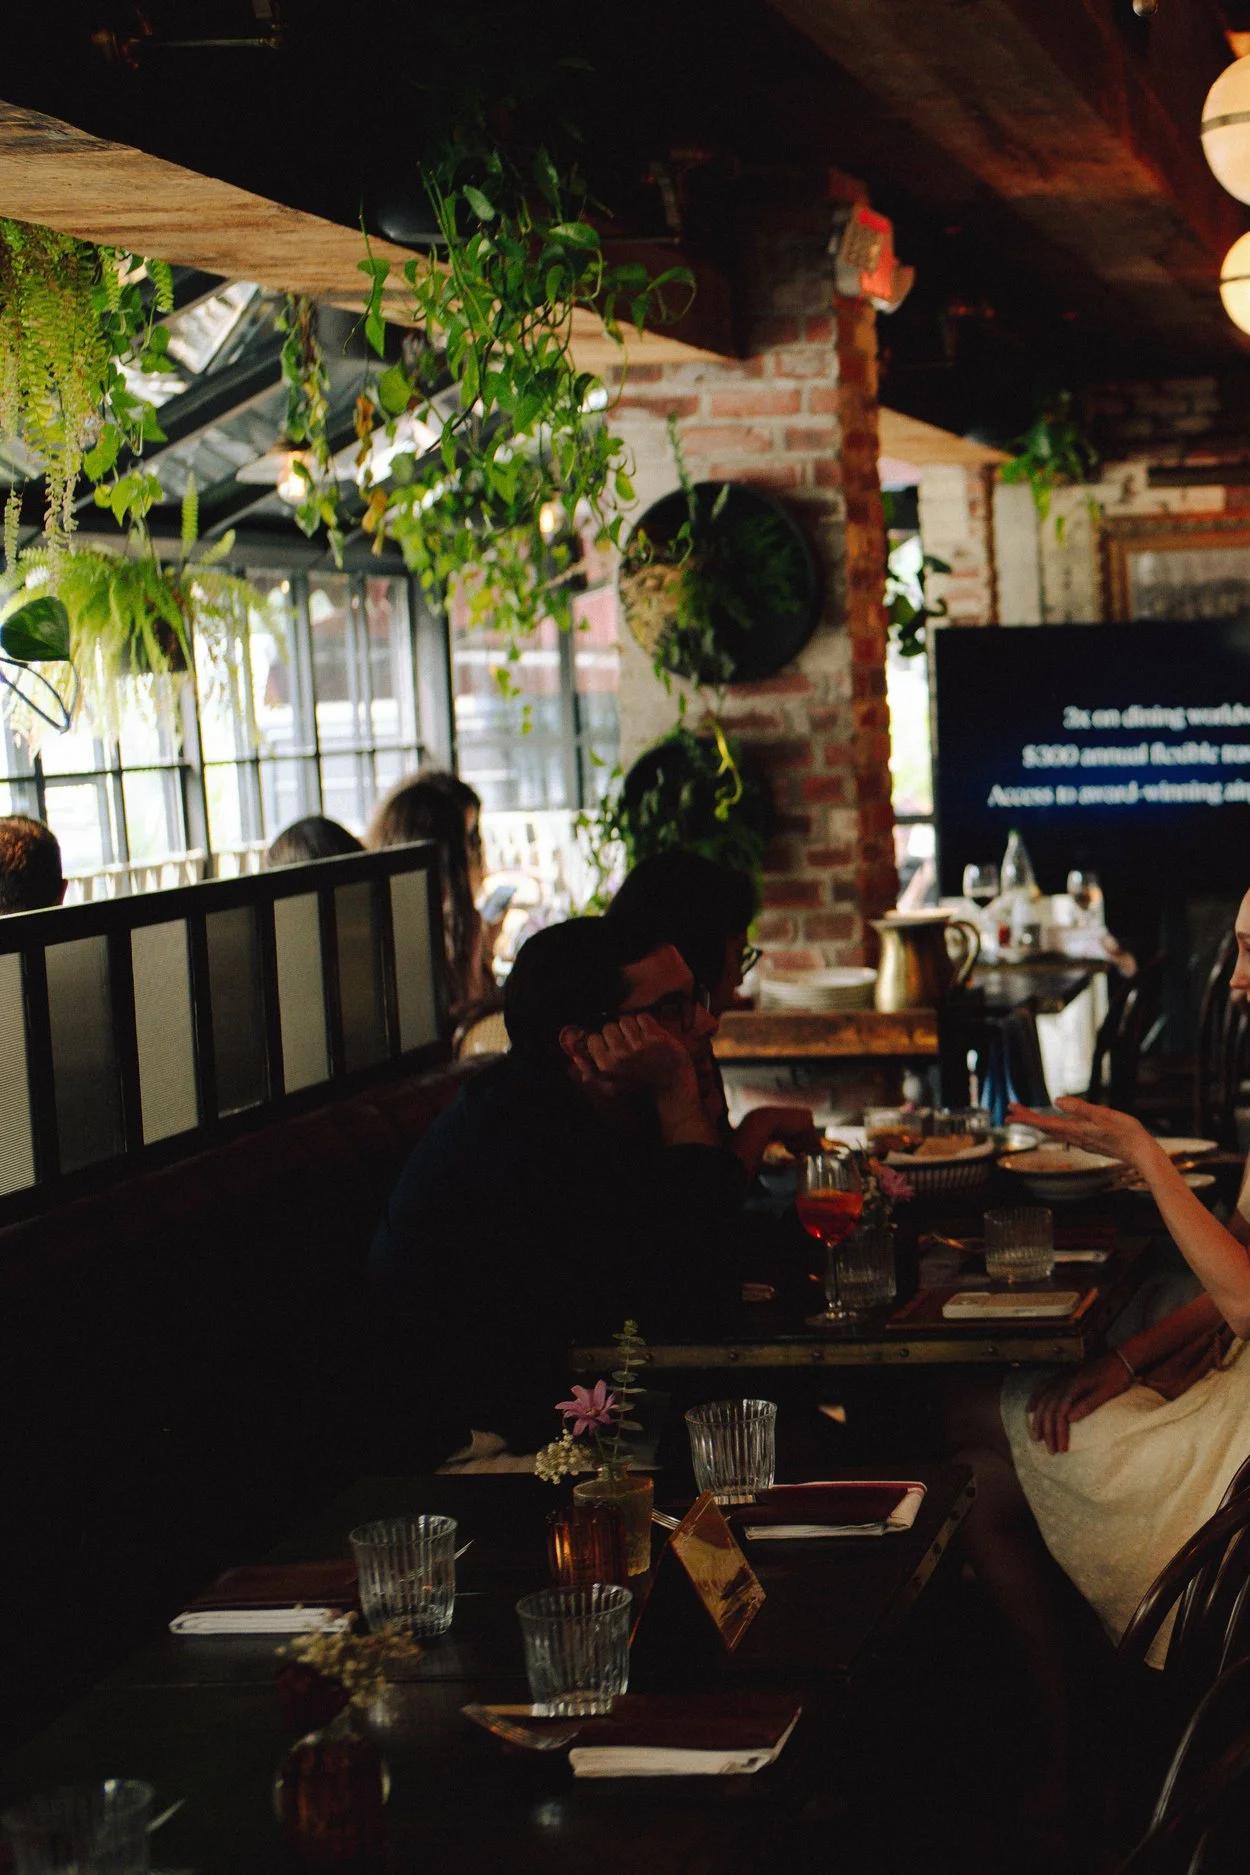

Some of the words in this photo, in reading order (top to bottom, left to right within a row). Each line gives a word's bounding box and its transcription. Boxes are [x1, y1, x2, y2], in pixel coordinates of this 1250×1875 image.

[1091, 708, 1121, 729] on
[1121, 704, 1187, 731] dining
[1080, 742, 1149, 768] annual
[1150, 741, 1218, 766] flexible
[987, 784, 1055, 808] Access
[1055, 785, 1078, 806] to
[1078, 780, 1223, 806] award-winning
